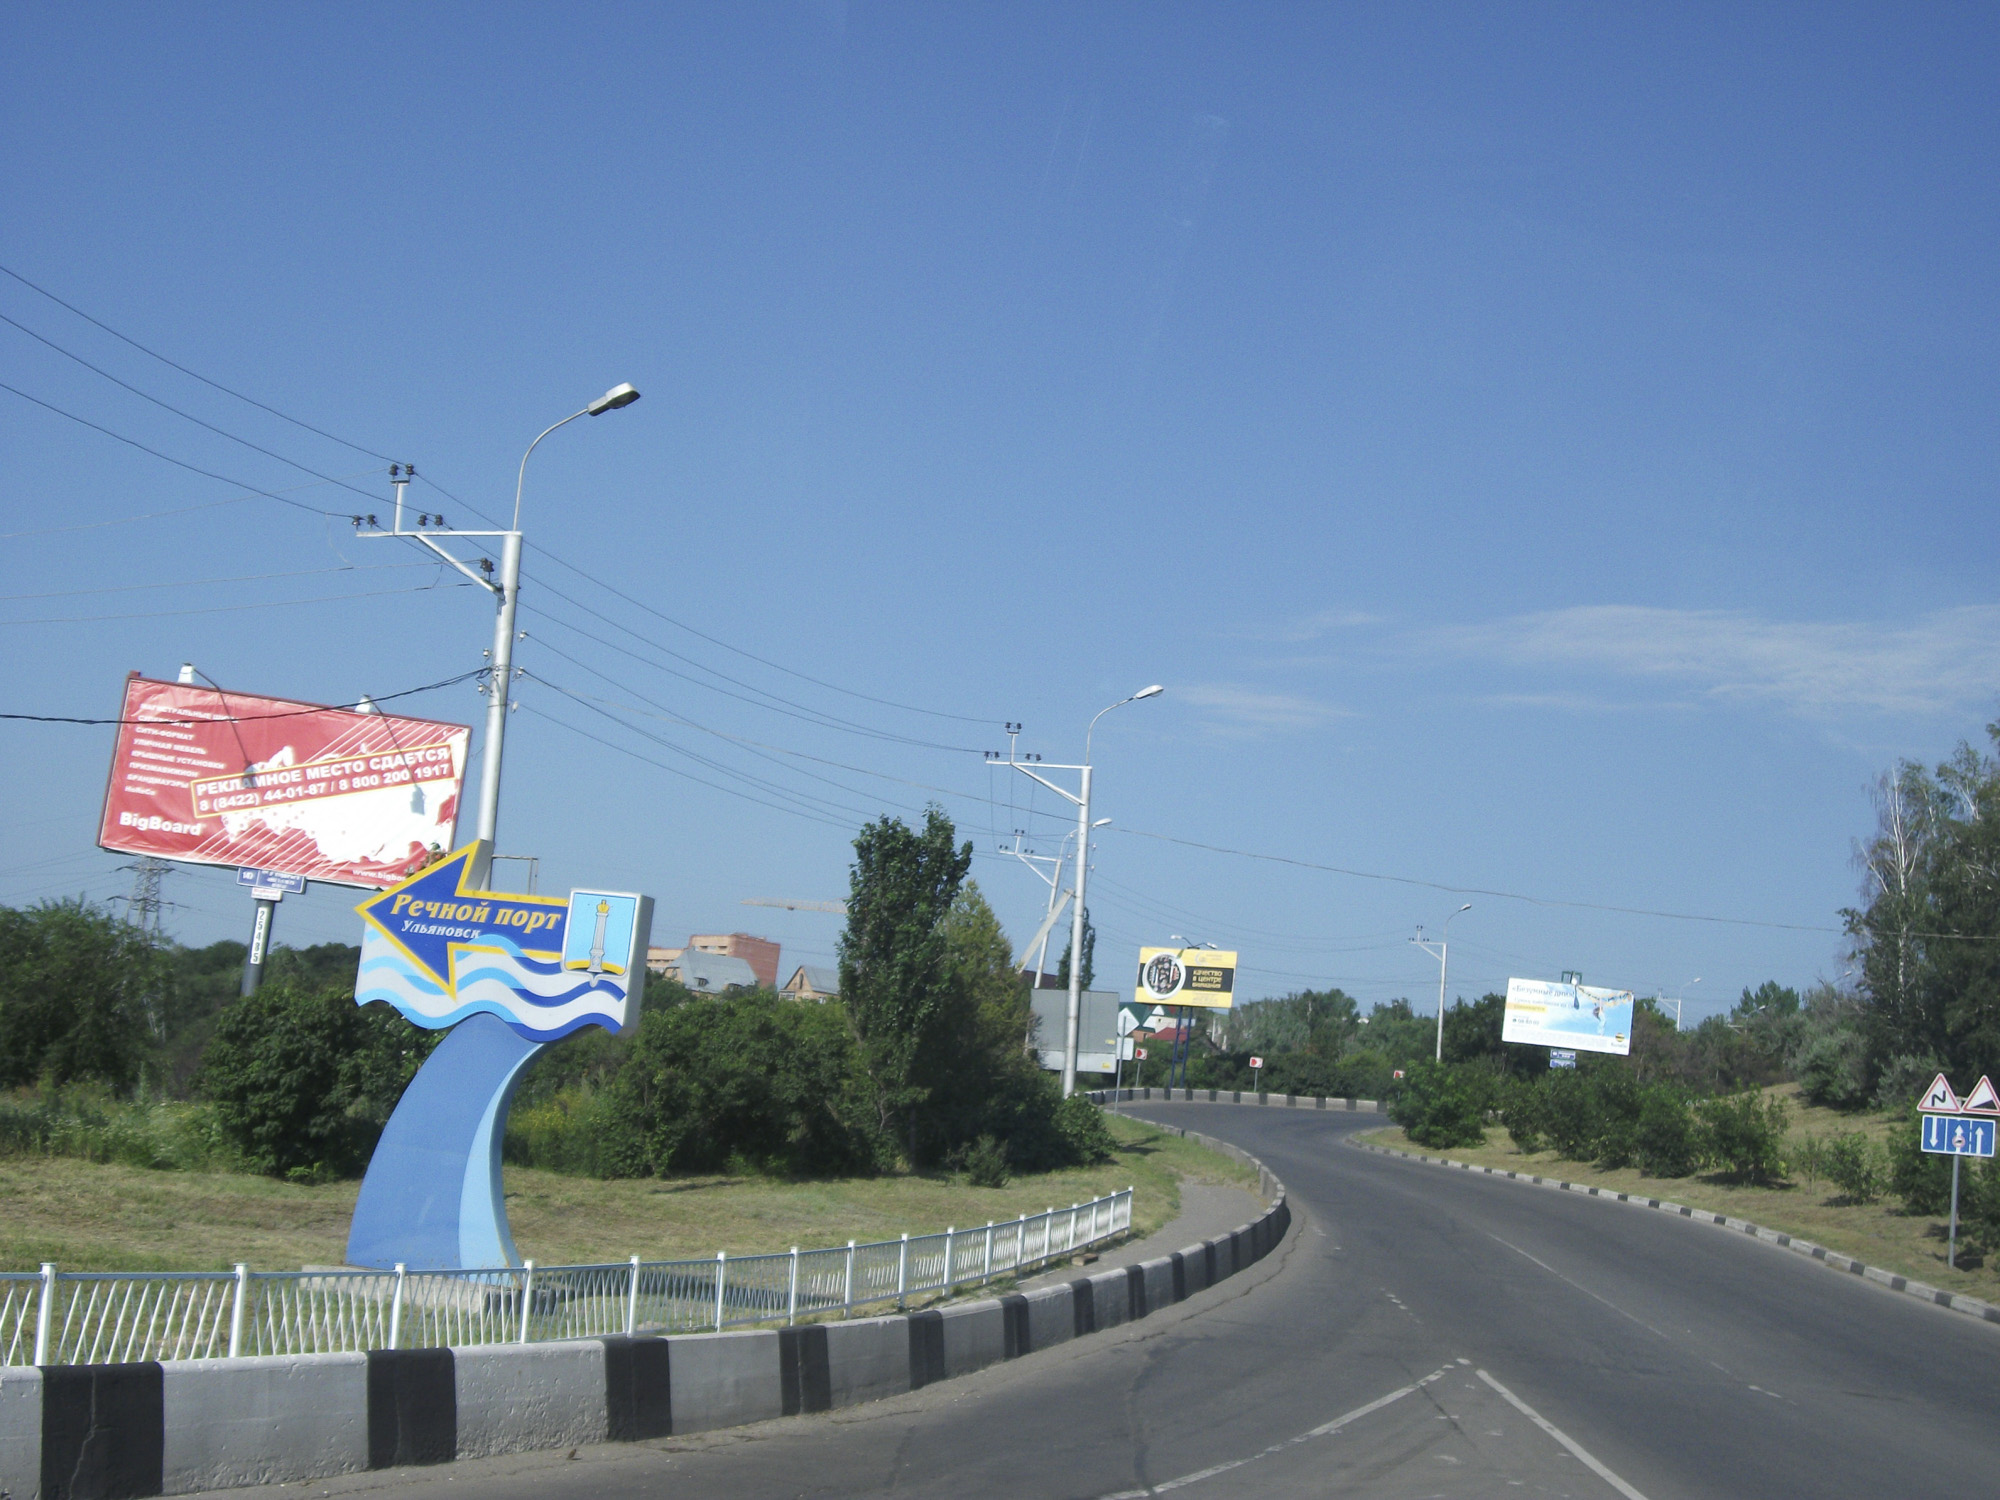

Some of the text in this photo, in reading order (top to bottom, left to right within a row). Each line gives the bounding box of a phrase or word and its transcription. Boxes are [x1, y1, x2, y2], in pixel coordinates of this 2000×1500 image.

[135, 726, 195, 740] СИТИ-ФОРМАТ
[133, 738, 207, 755] УЛИЧНАЯ МЕБЕЛЬ
[131, 750, 226, 770] КРЫШНЫЕ УСТАНОВКИ
[195, 747, 450, 796] РЕКЛАМНОЕ МЕСТО СДАЕТСЯ
[199, 800, 209, 812] 8
[212, 793, 260, 812] (8422)
[263, 782, 327, 801] 44-01-87
[338, 779, 349, 791] 8
[352, 774, 380, 789] 800
[382, 769, 411, 784] 200
[414, 763, 450, 779] 1917
[119, 811, 203, 836] BigBoard
[390, 894, 561, 934] Речной порт
[401, 919, 481, 939] Ульяновск
